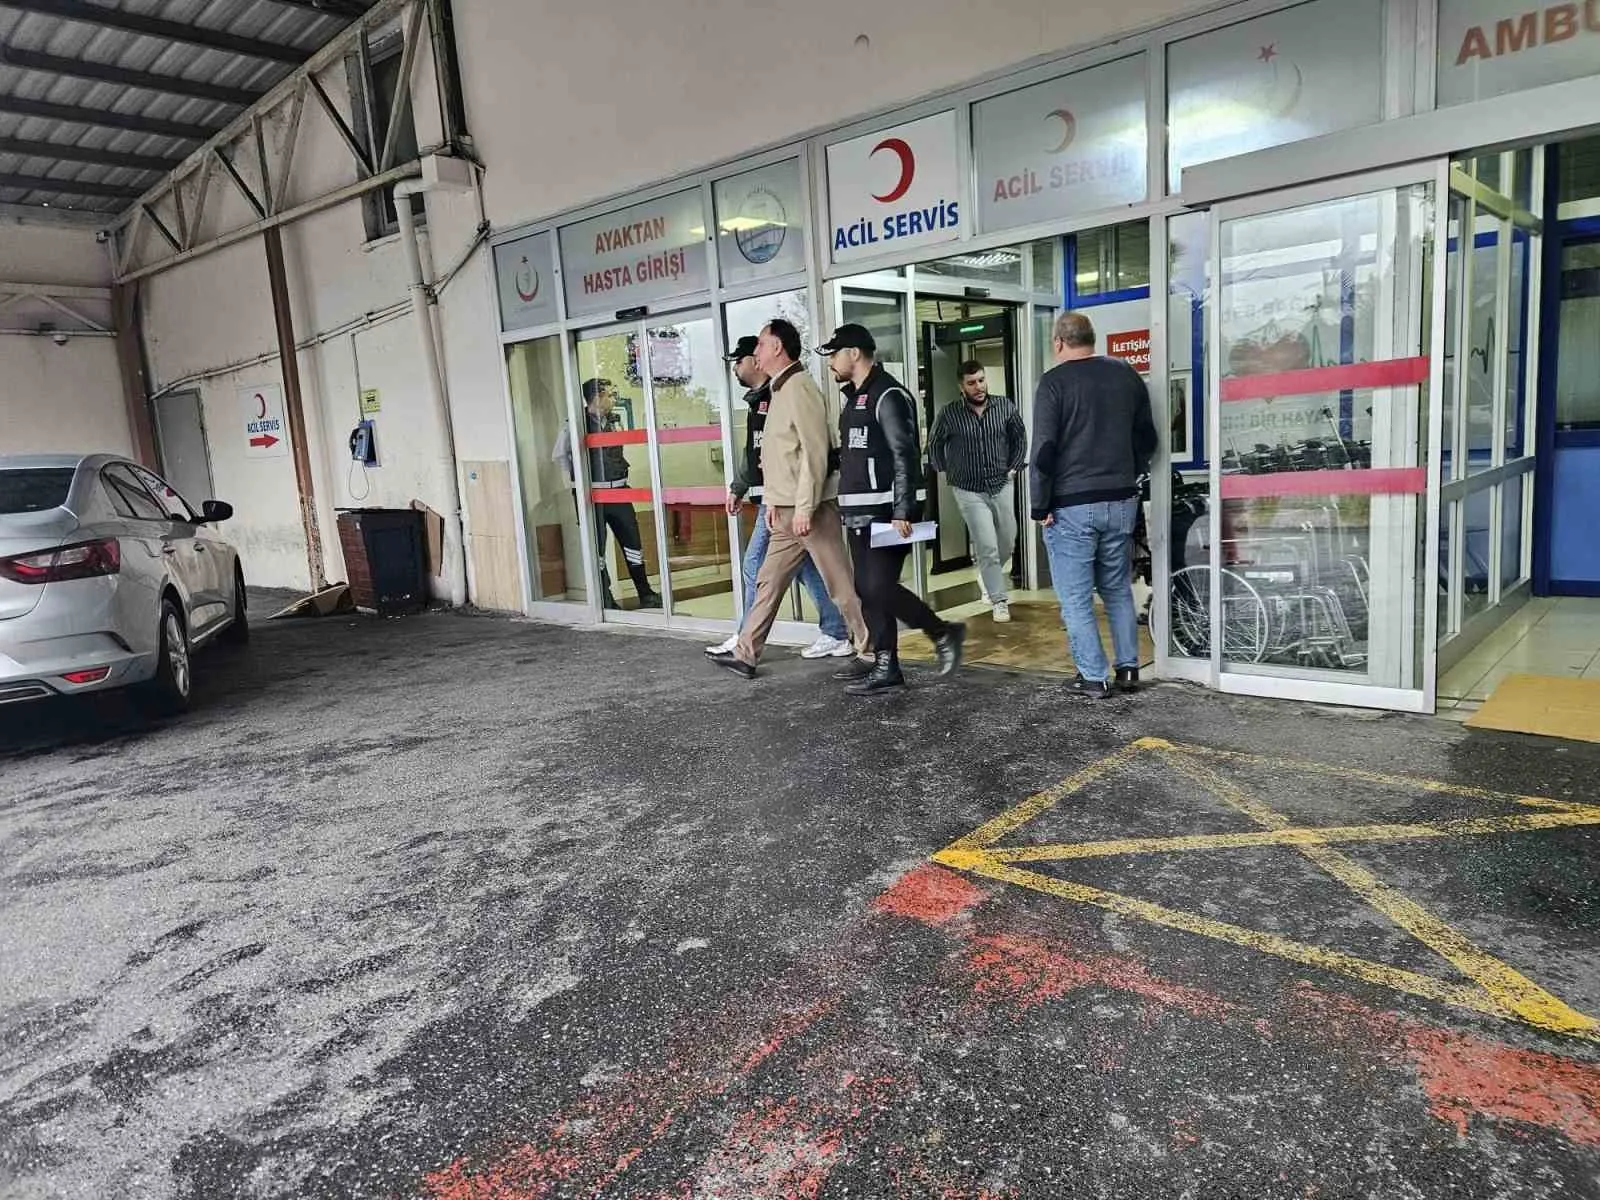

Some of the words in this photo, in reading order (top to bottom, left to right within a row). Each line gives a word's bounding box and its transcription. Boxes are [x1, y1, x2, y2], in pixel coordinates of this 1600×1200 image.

[994, 167, 1043, 203] ACİL
[595, 216, 665, 254] AYAKTAN
[834, 216, 878, 250] ACİL
[883, 200, 959, 240] SERVİS
[583, 265, 633, 294] HASTA
[636, 248, 685, 281] GİRİŞİ
